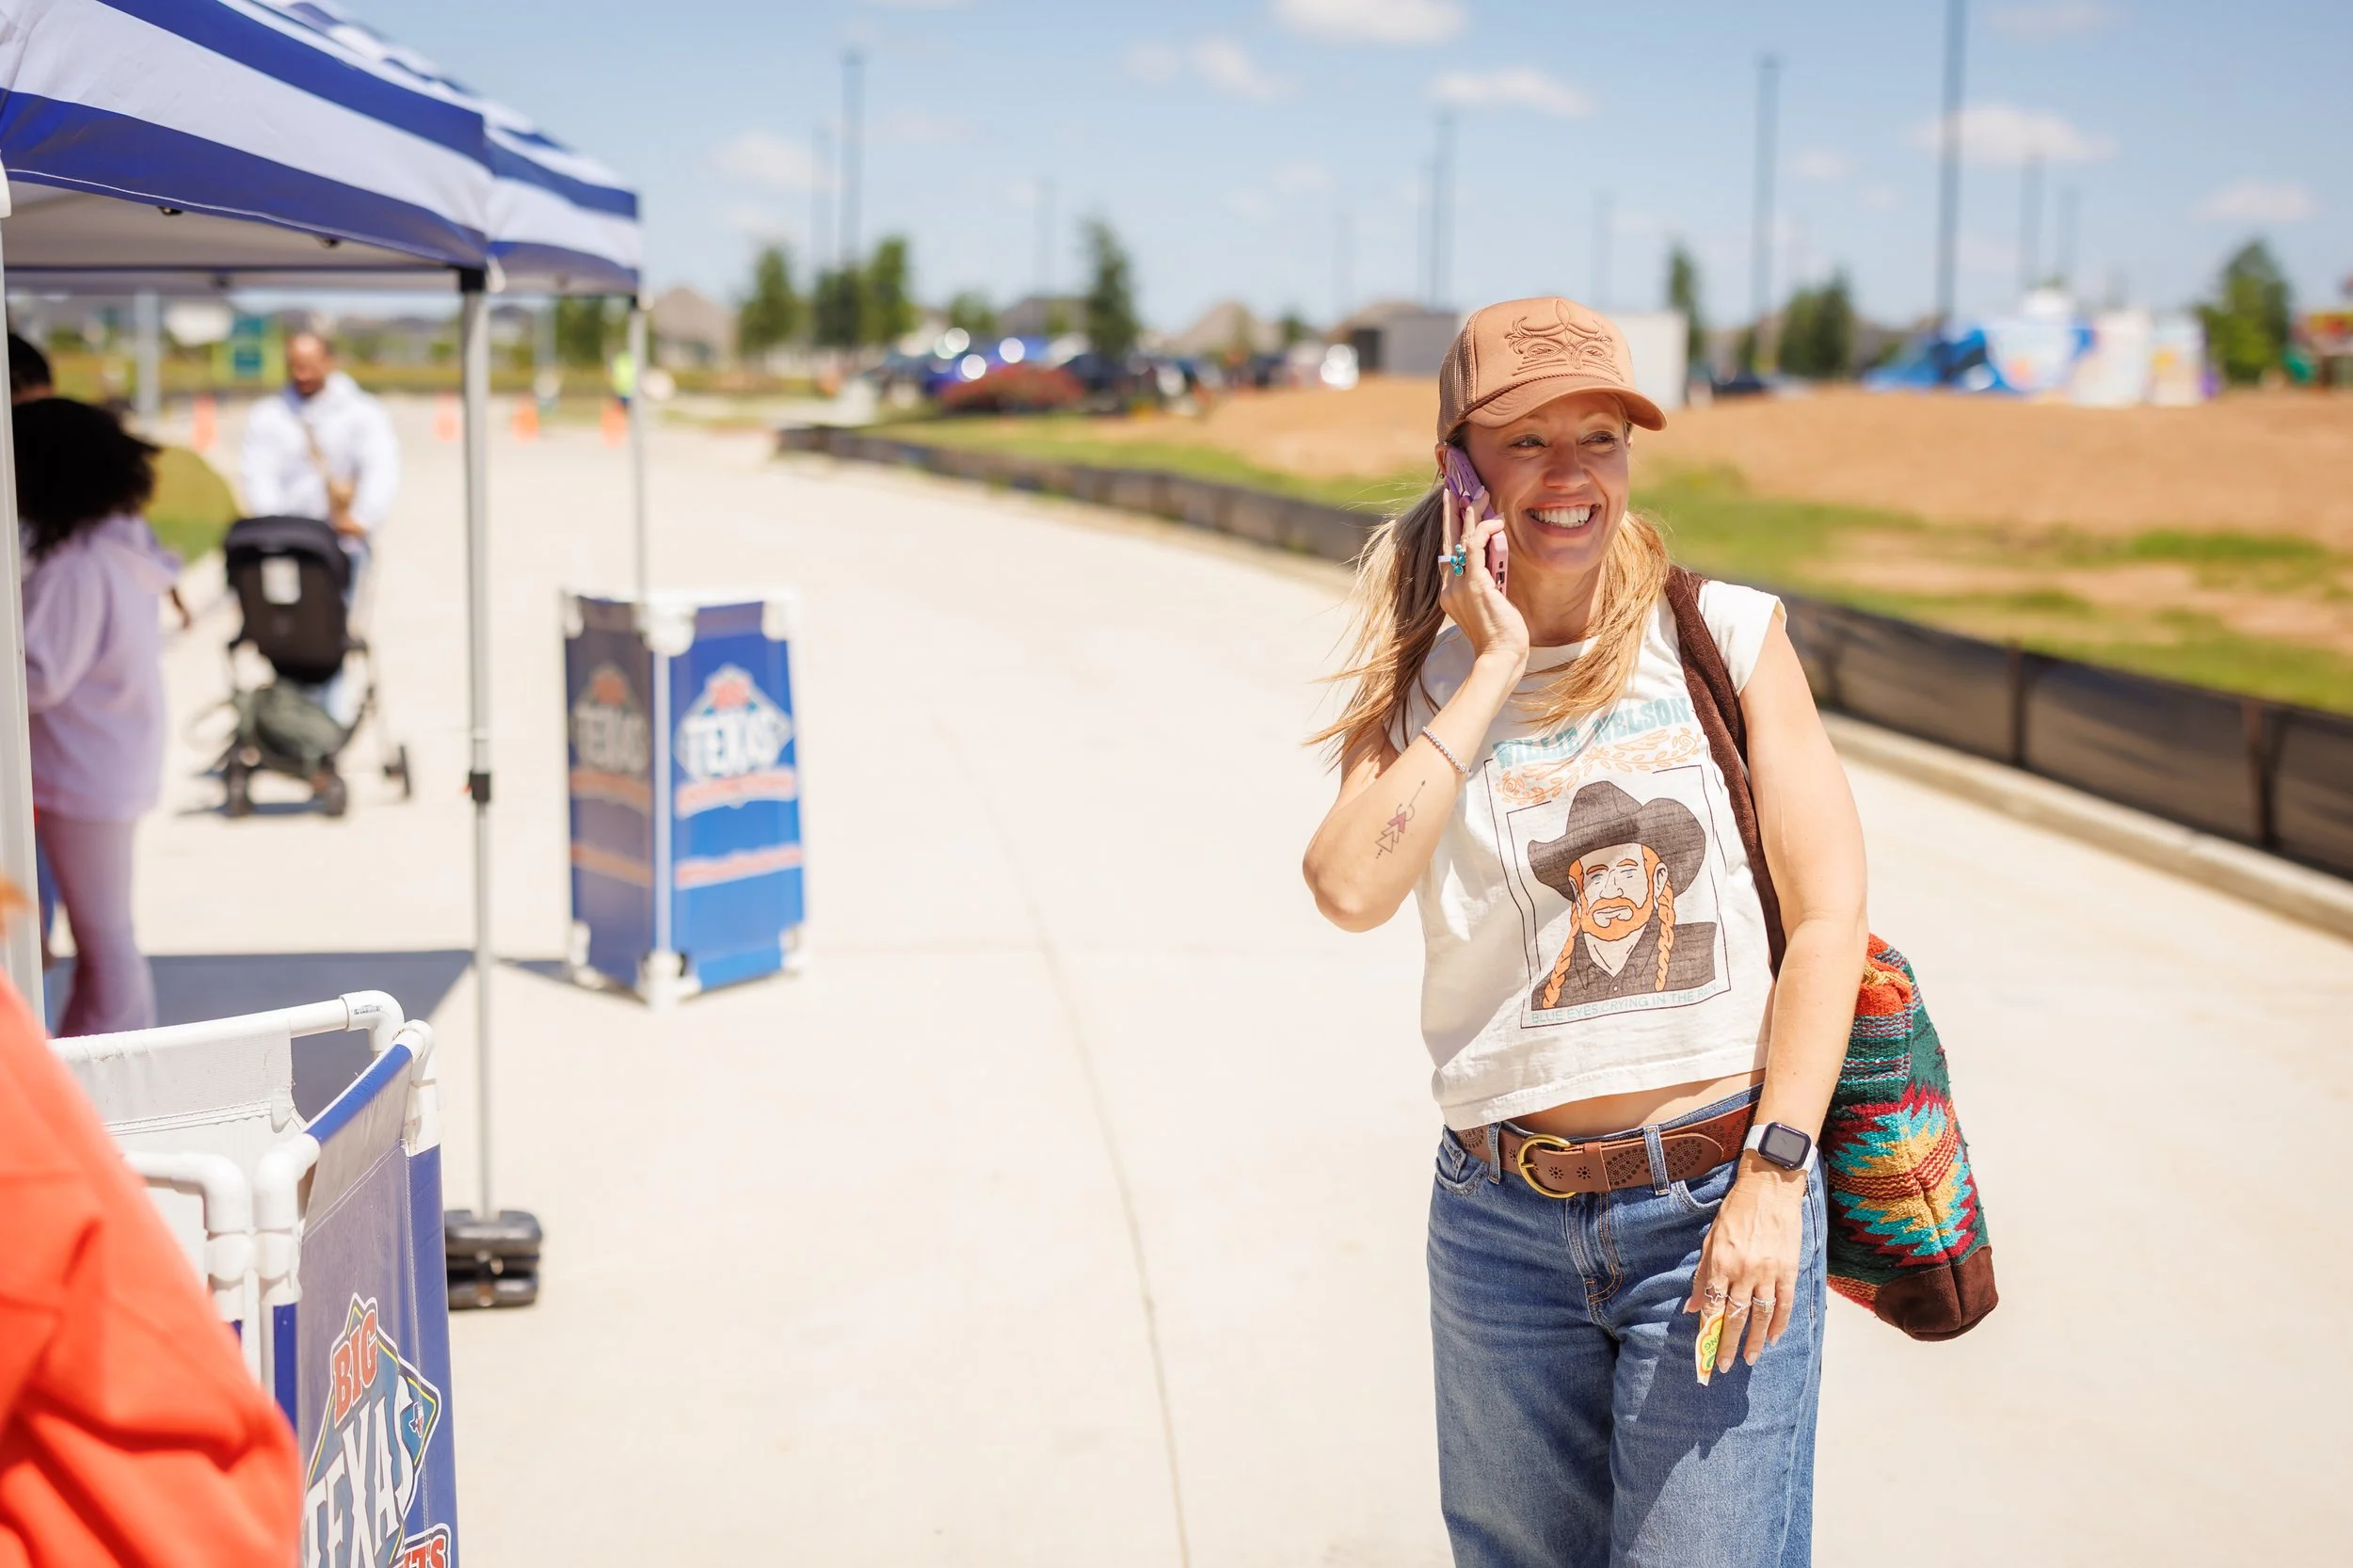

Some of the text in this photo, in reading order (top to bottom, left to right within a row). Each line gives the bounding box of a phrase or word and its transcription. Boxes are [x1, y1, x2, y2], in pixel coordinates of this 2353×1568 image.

[1592, 697, 1691, 744] NELSON
[1531, 1009, 1563, 1023] BLUE
[1566, 1002, 1599, 1018] EYES
[1601, 996, 1649, 1013] CRYING
[1652, 994, 1666, 1006] IN
[1671, 991, 1694, 1004] THE
[333, 1311, 376, 1429] BIG
[304, 1375, 414, 1568] TEXAS
